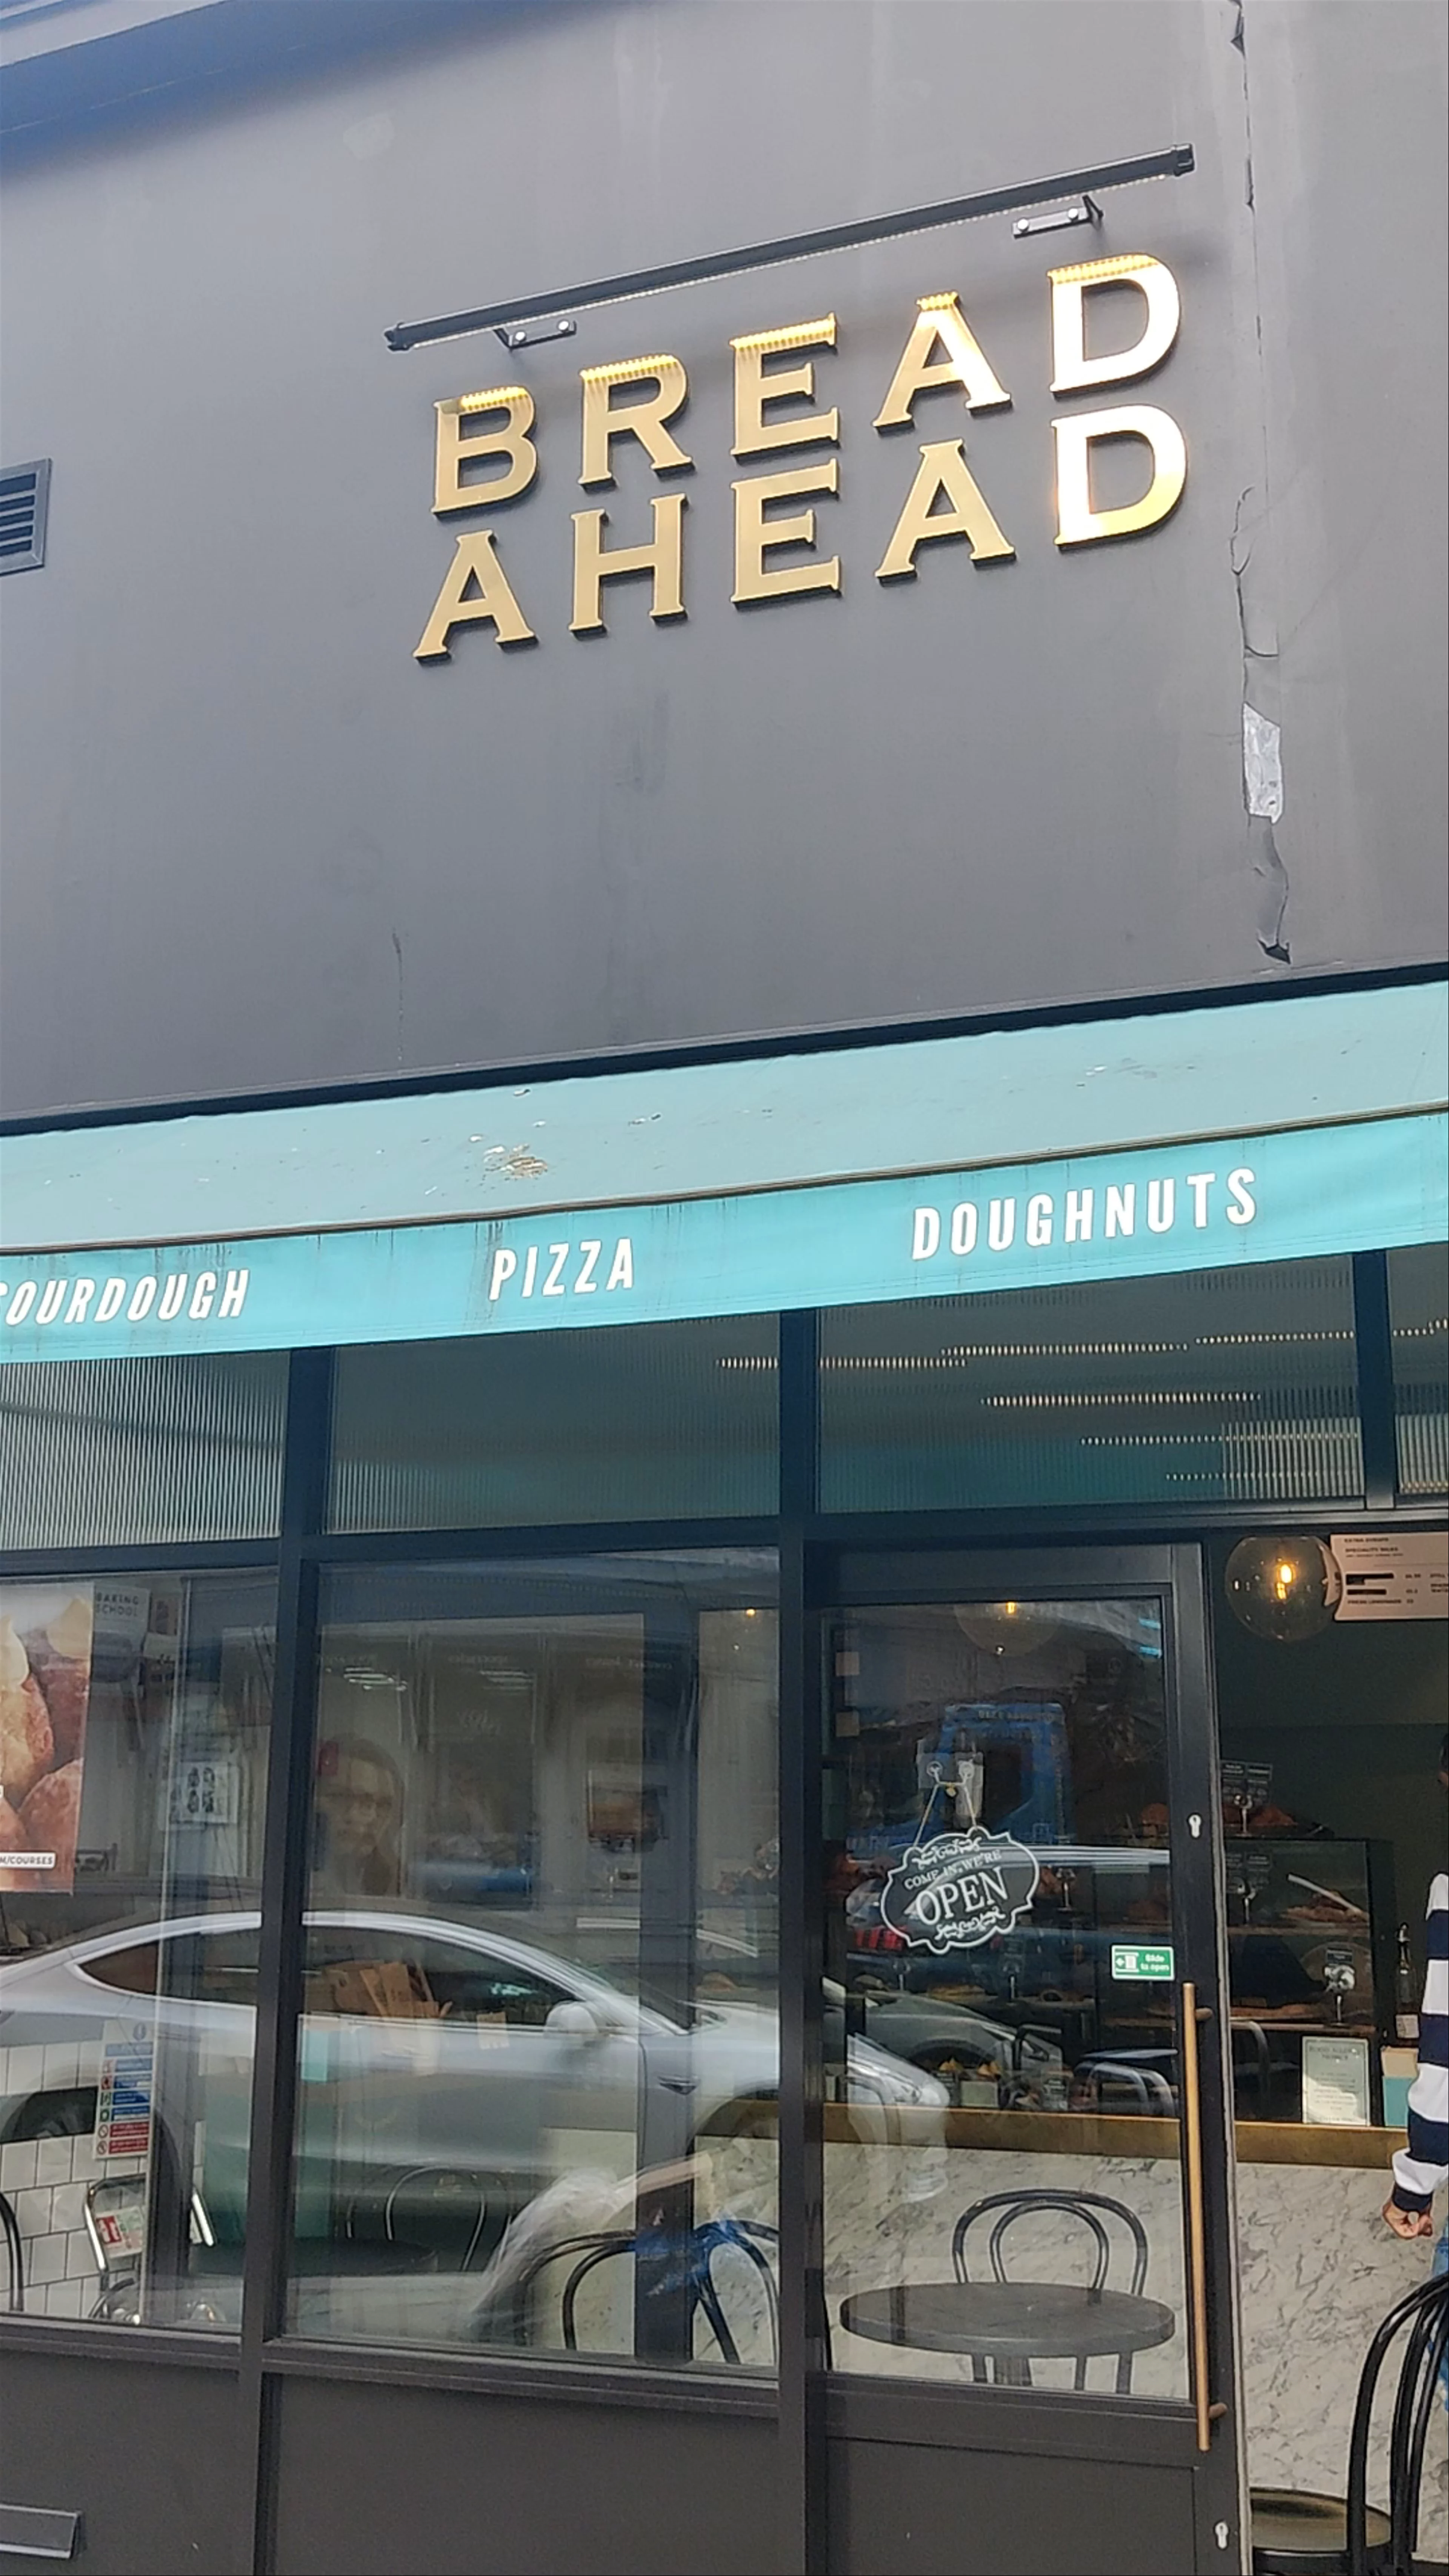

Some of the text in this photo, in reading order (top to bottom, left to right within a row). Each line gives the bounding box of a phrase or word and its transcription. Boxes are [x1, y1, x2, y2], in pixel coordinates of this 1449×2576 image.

[431, 253, 1181, 521] BREAD
[412, 404, 1188, 664] AHEAD
[911, 1167, 1257, 1261] DOUGHNUTS
[0, 1269, 249, 1326] OURDOUGH
[488, 1237, 634, 1301] PIZZA
[97, 1592, 139, 1606] BAKING
[904, 1869, 939, 1890] COME
[915, 1866, 1008, 1925] OPEN
